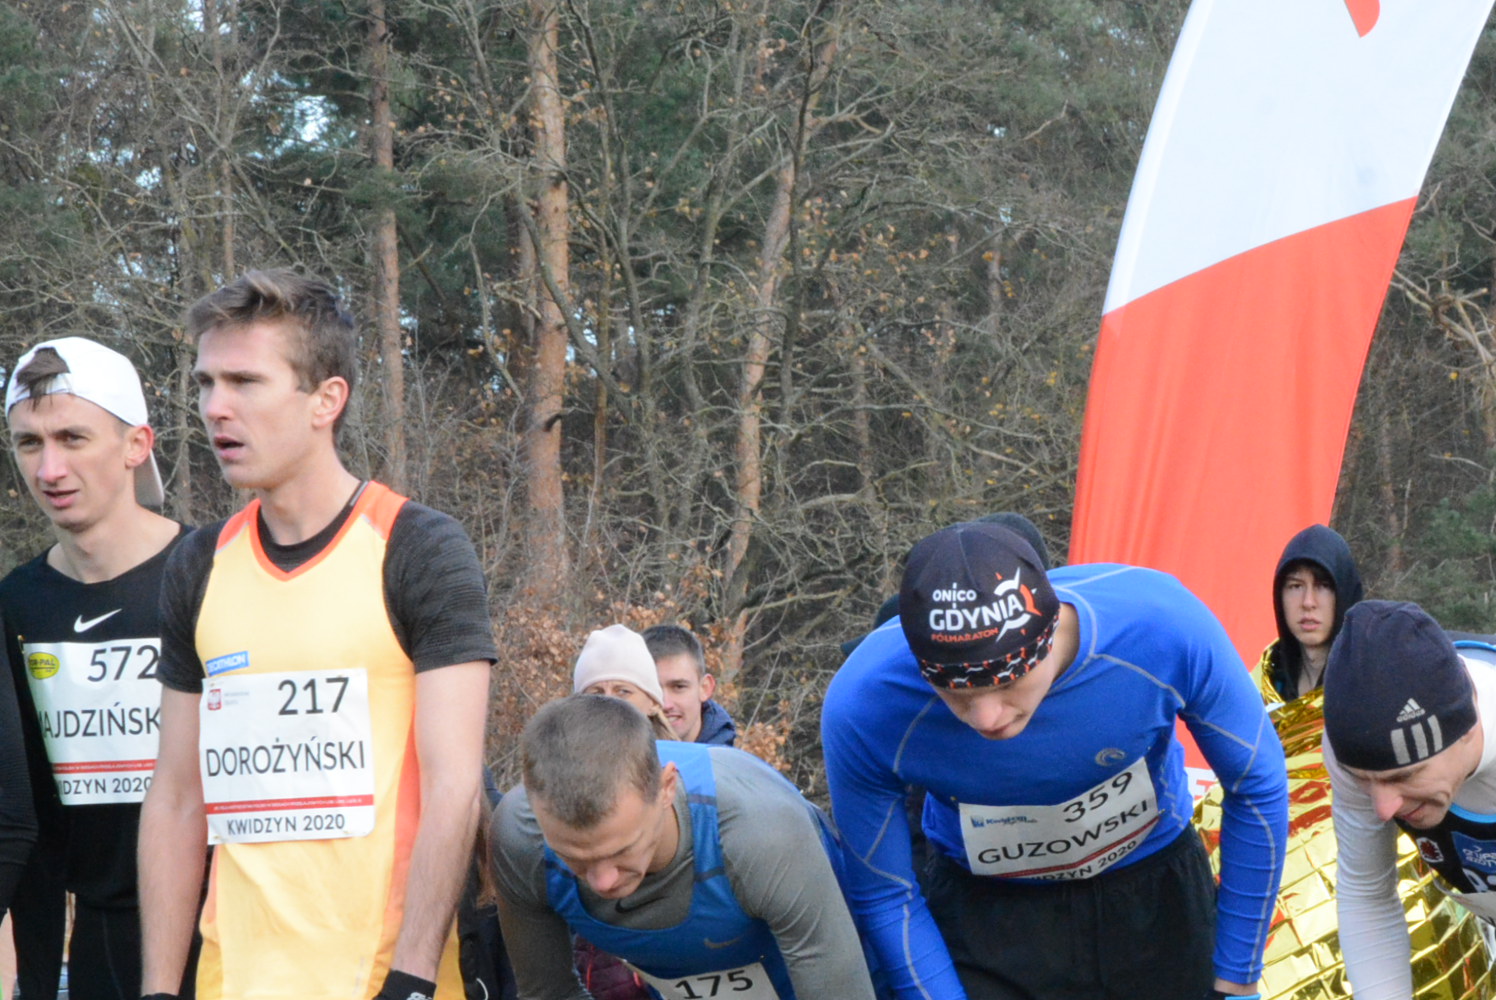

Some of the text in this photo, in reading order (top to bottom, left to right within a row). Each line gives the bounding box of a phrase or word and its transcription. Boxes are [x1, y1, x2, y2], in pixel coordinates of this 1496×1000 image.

[932, 582, 977, 602] ONICO
[929, 594, 1024, 631] GDYNIA
[87, 645, 159, 682] 572
[278, 677, 350, 715] 217
[39, 701, 160, 739] AJDZIŃSK
[206, 736, 365, 777] DOROŻYŃSKI
[1063, 772, 1132, 823] 359
[227, 814, 346, 836] KWIDZYN 2020
[978, 800, 1147, 864] GUZOWSKI
[1098, 840, 1137, 867] 2020
[674, 970, 753, 1000] 175
